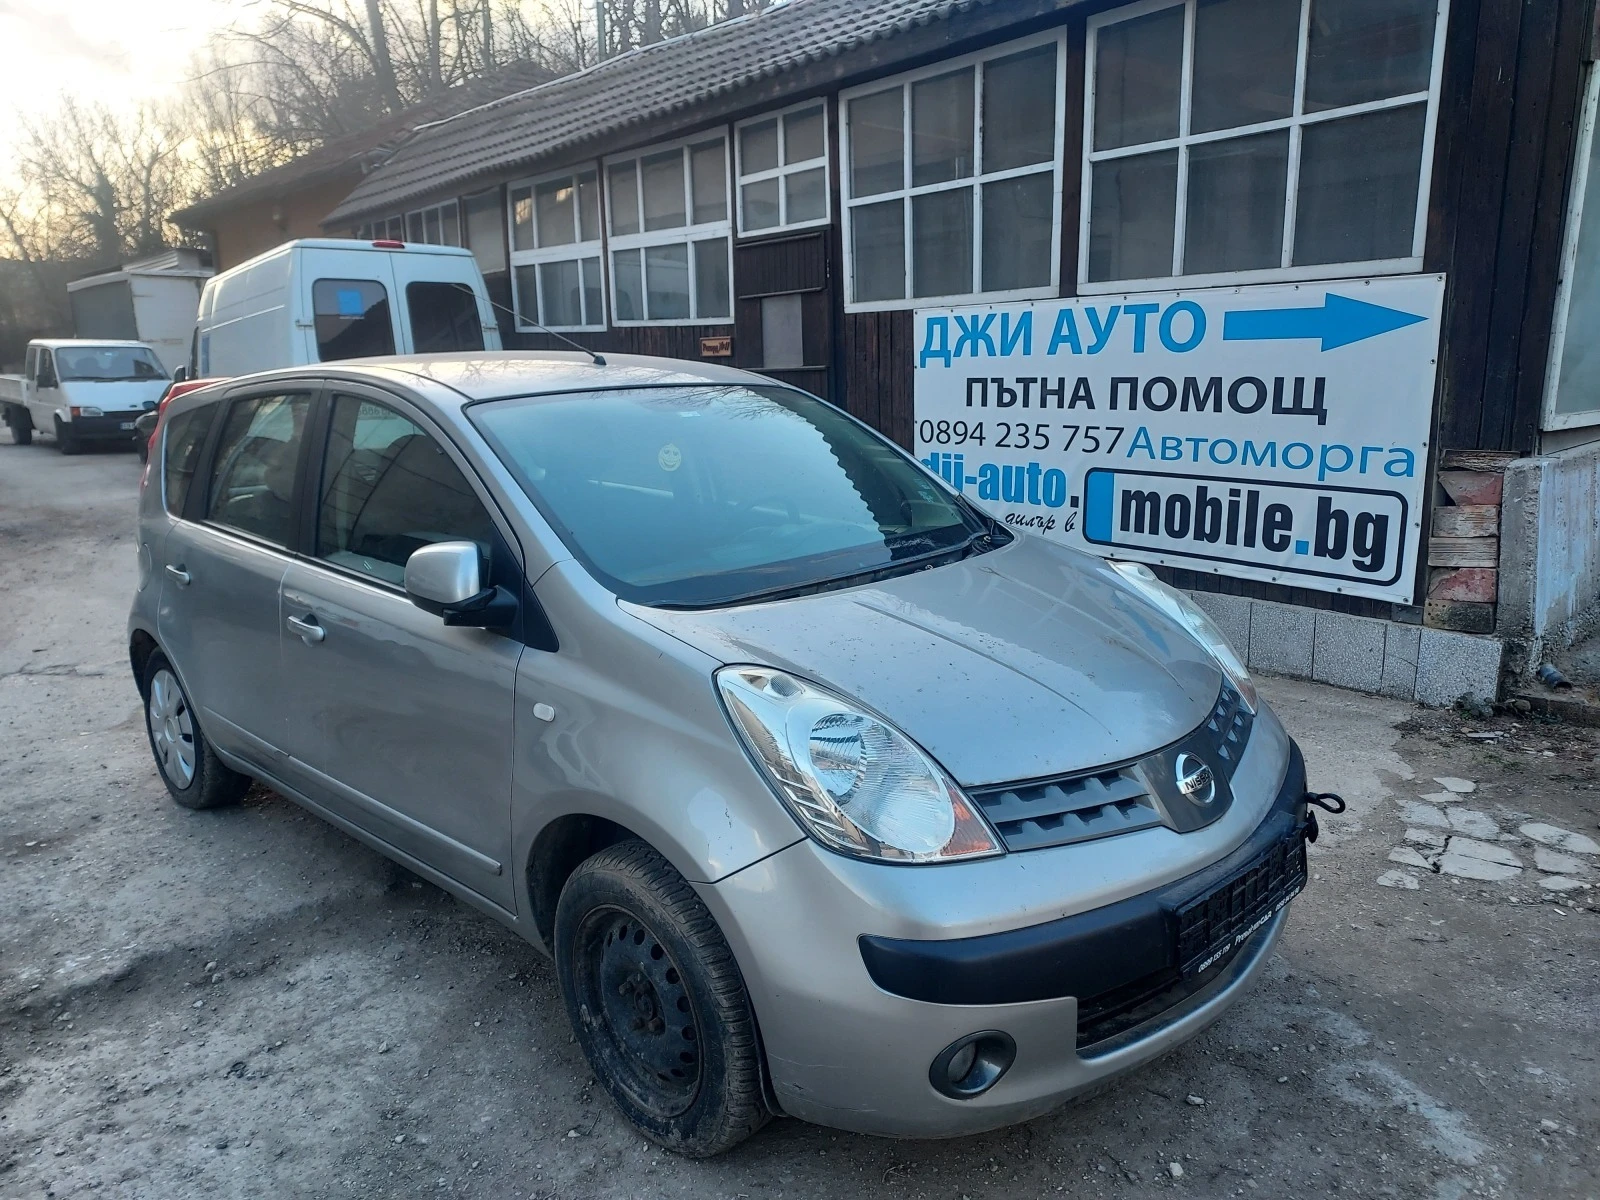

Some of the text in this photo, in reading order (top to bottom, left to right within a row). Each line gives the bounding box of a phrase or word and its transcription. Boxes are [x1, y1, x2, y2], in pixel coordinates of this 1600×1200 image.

[920, 300, 1207, 368] ДЖИ АУТО
[965, 376, 1327, 425] ПЪТНА ПОМОЩ
[919, 419, 1125, 455] 0894 235 757
[1126, 426, 1415, 480] Автоморга
[1120, 485, 1390, 573] mobile.bg
